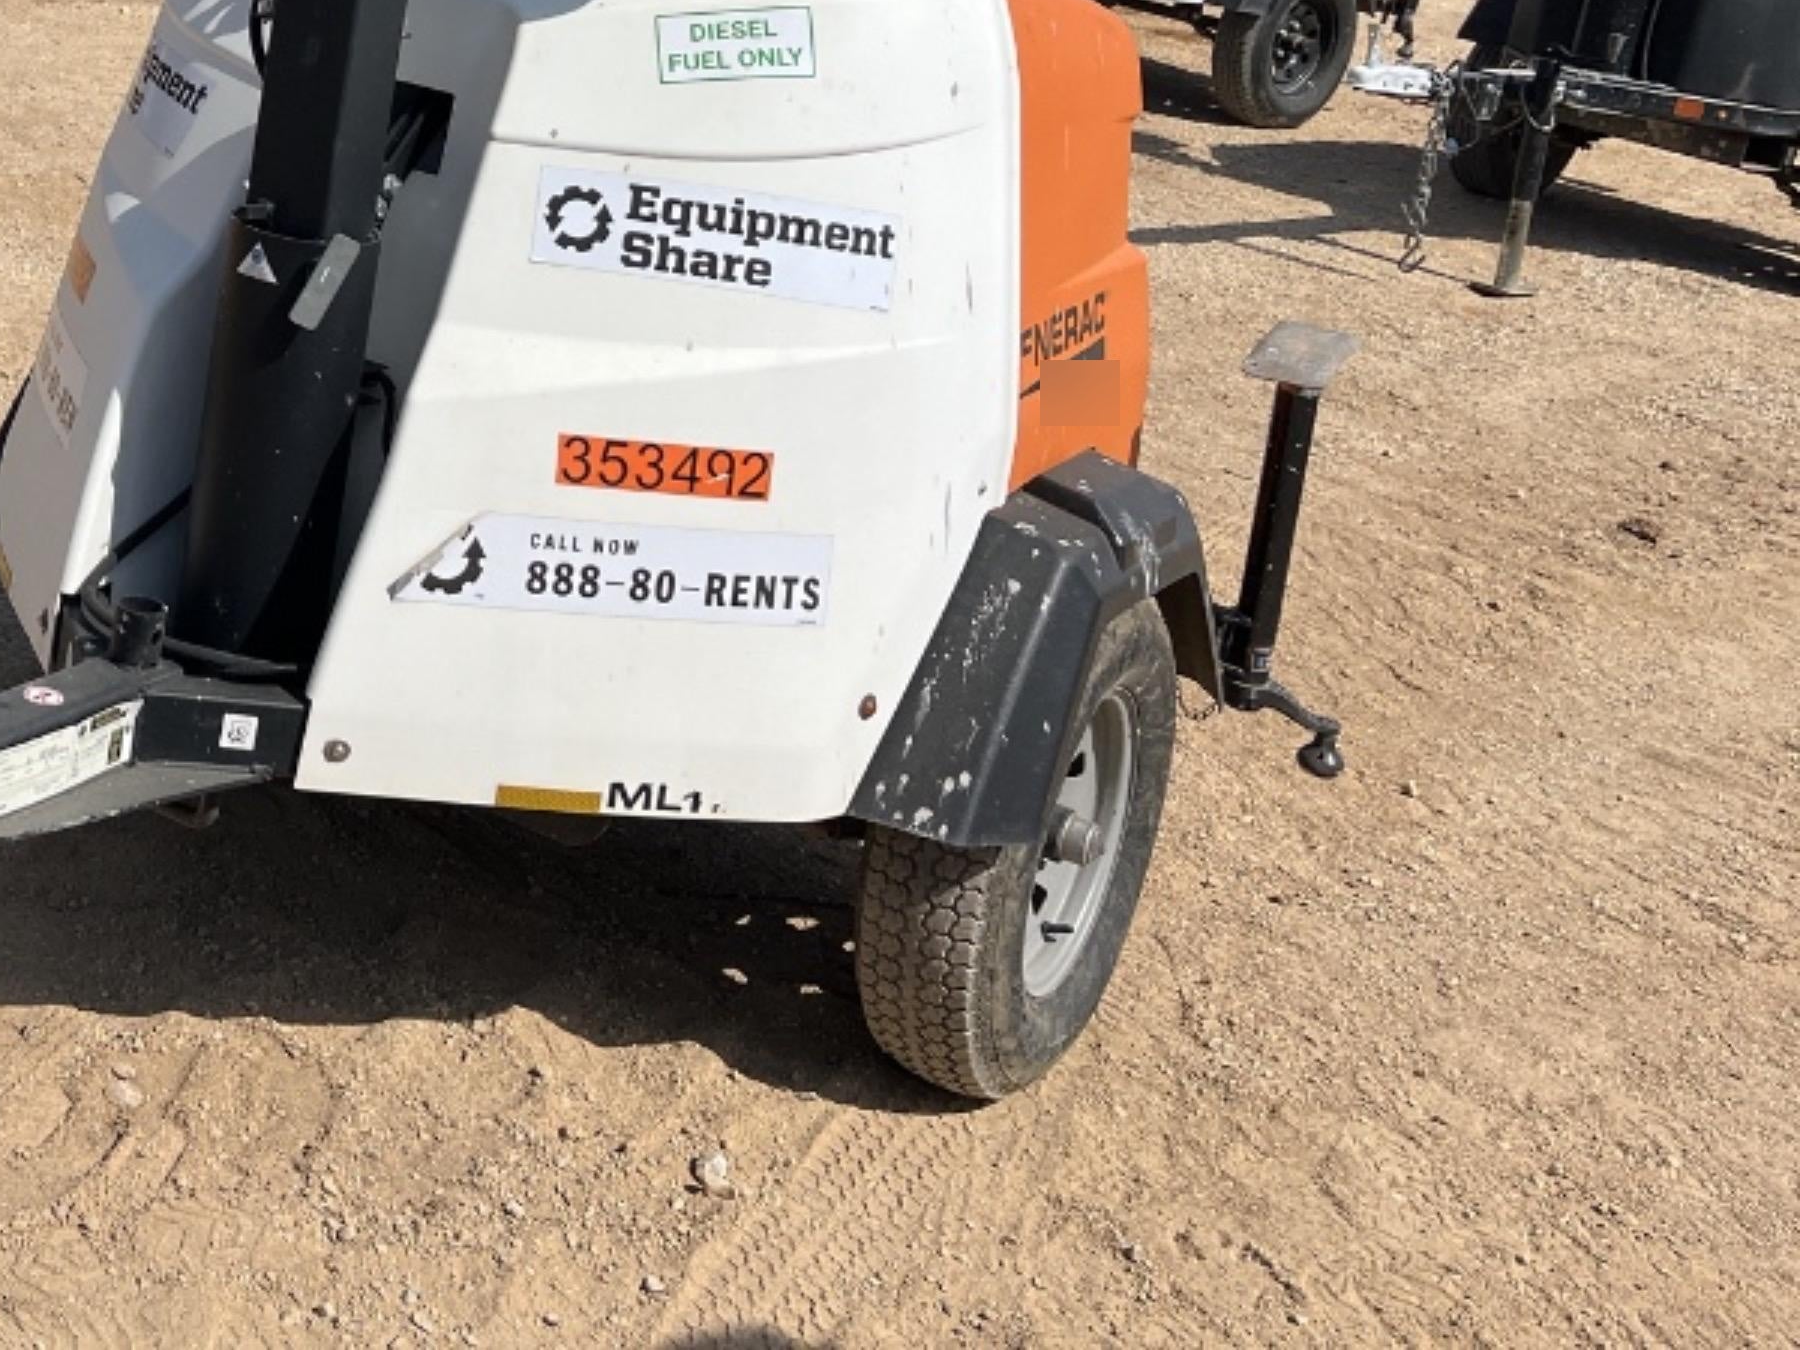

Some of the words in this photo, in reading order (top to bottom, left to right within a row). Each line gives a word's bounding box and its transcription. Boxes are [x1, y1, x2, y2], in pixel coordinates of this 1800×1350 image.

[689, 18, 778, 43] DIESEL
[668, 51, 732, 73] FUEL
[737, 46, 803, 68] ONLY
[625, 182, 897, 261] Equipment
[620, 229, 773, 288] Share
[1020, 290, 1107, 367] ENERAC
[561, 435, 770, 499] 353492
[529, 532, 581, 553] CALL
[592, 536, 640, 556] NOW
[525, 559, 822, 612] 888-80-RENTS
